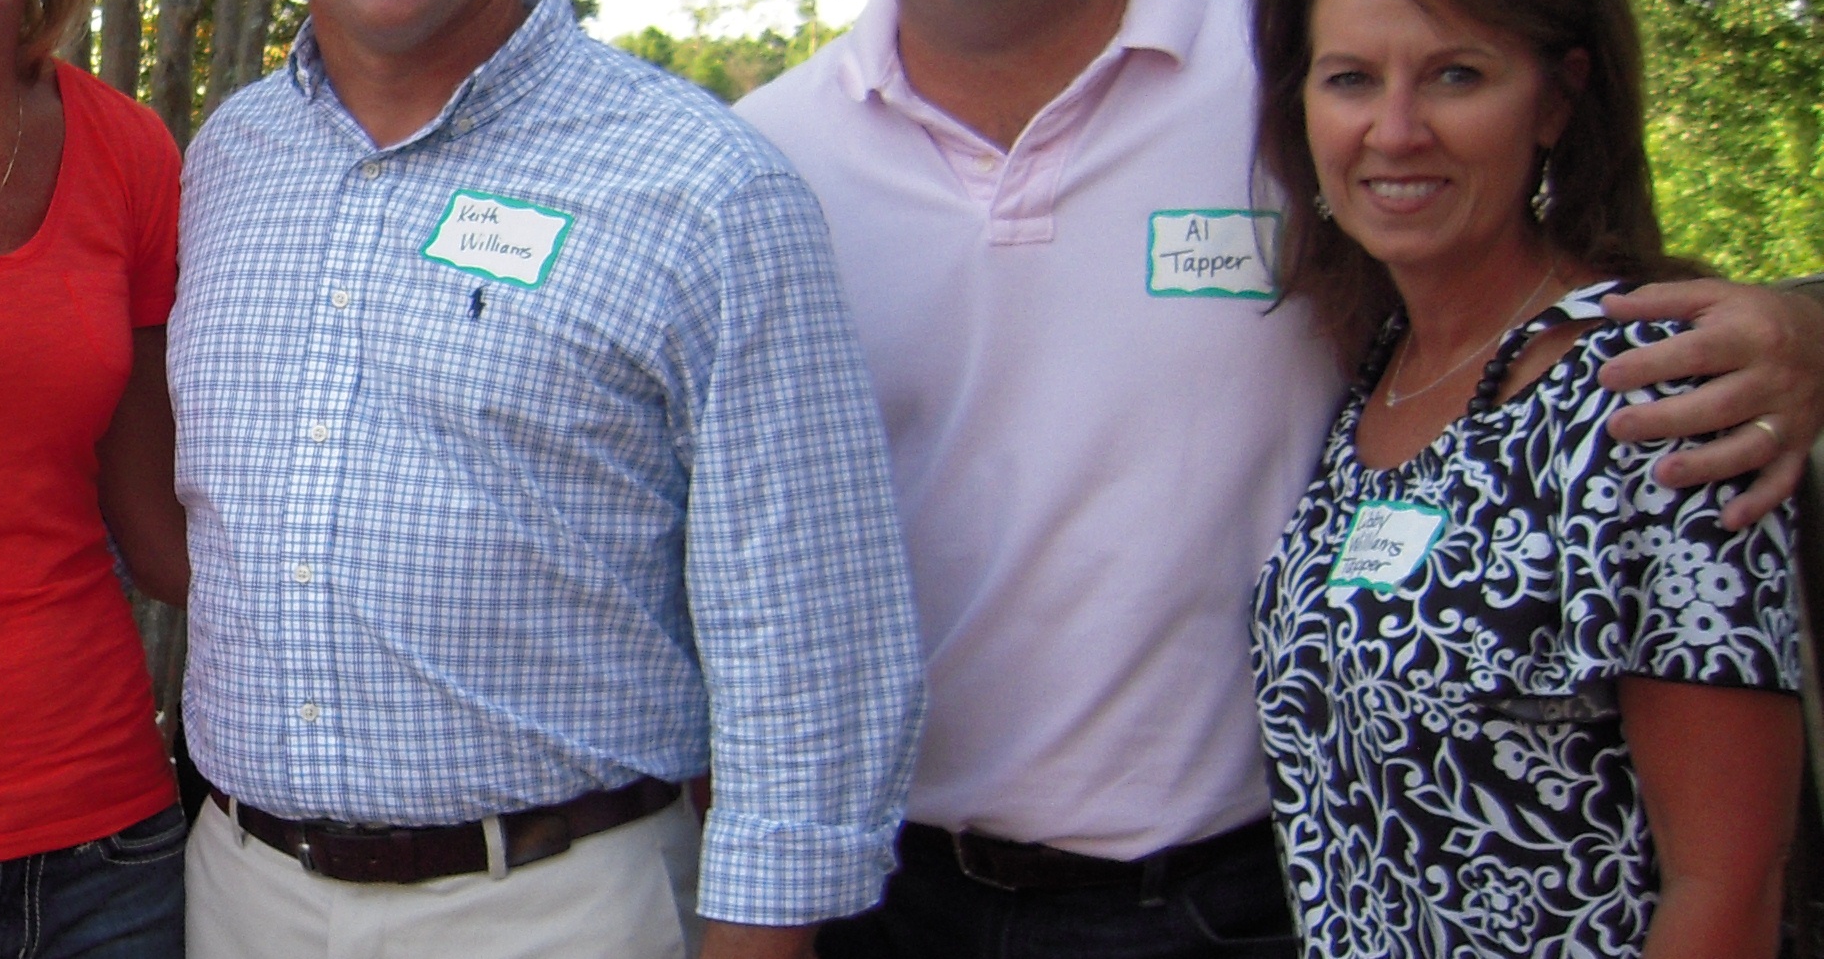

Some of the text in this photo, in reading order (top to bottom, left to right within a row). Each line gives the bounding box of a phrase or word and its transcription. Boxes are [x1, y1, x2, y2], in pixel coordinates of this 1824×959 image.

[457, 205, 499, 224] Keith
[1186, 219, 1209, 241] Al
[460, 233, 532, 259] Williams
[1160, 249, 1252, 277] Tapper
